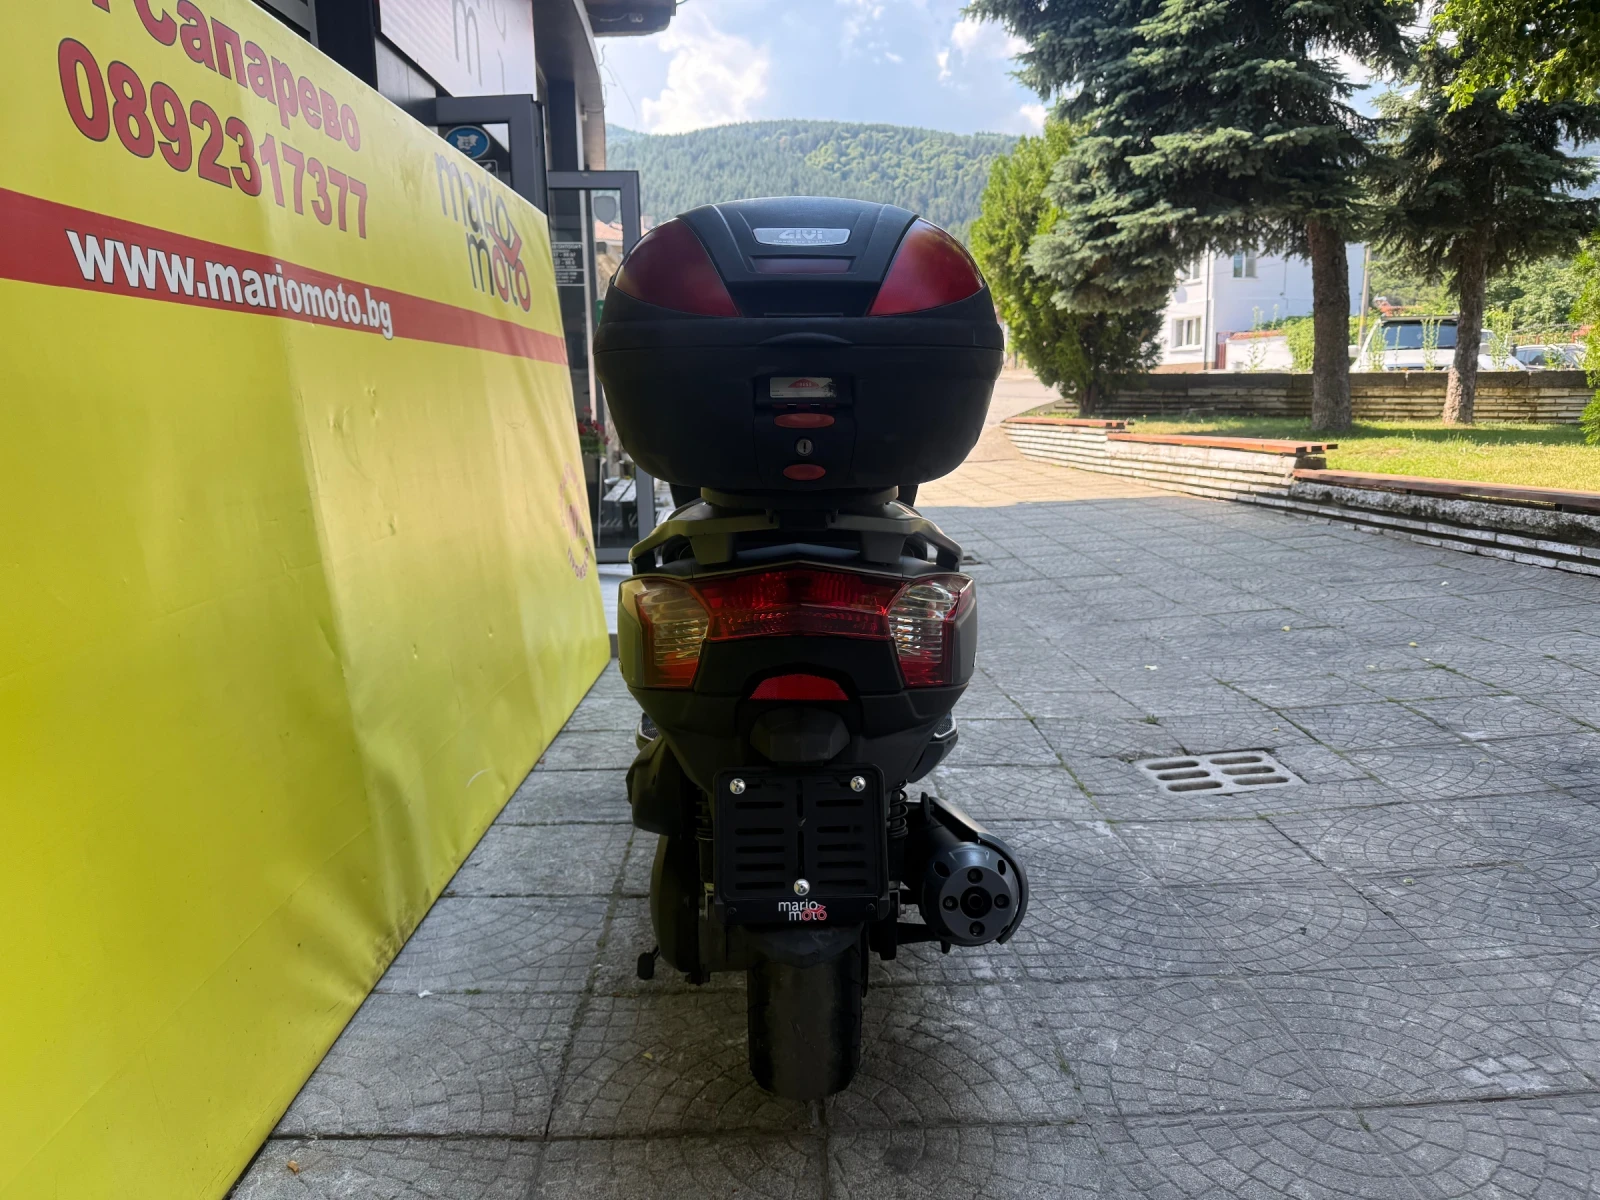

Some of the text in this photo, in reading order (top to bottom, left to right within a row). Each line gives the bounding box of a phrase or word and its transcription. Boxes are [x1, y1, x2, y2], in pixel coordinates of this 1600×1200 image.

[57, 37, 368, 239] 0892317377
[434, 152, 511, 247] mario
[64, 228, 394, 341] www.mariomoto.bg
[466, 232, 532, 312] moto
[778, 898, 818, 911] mario
[788, 909, 827, 921] moto
